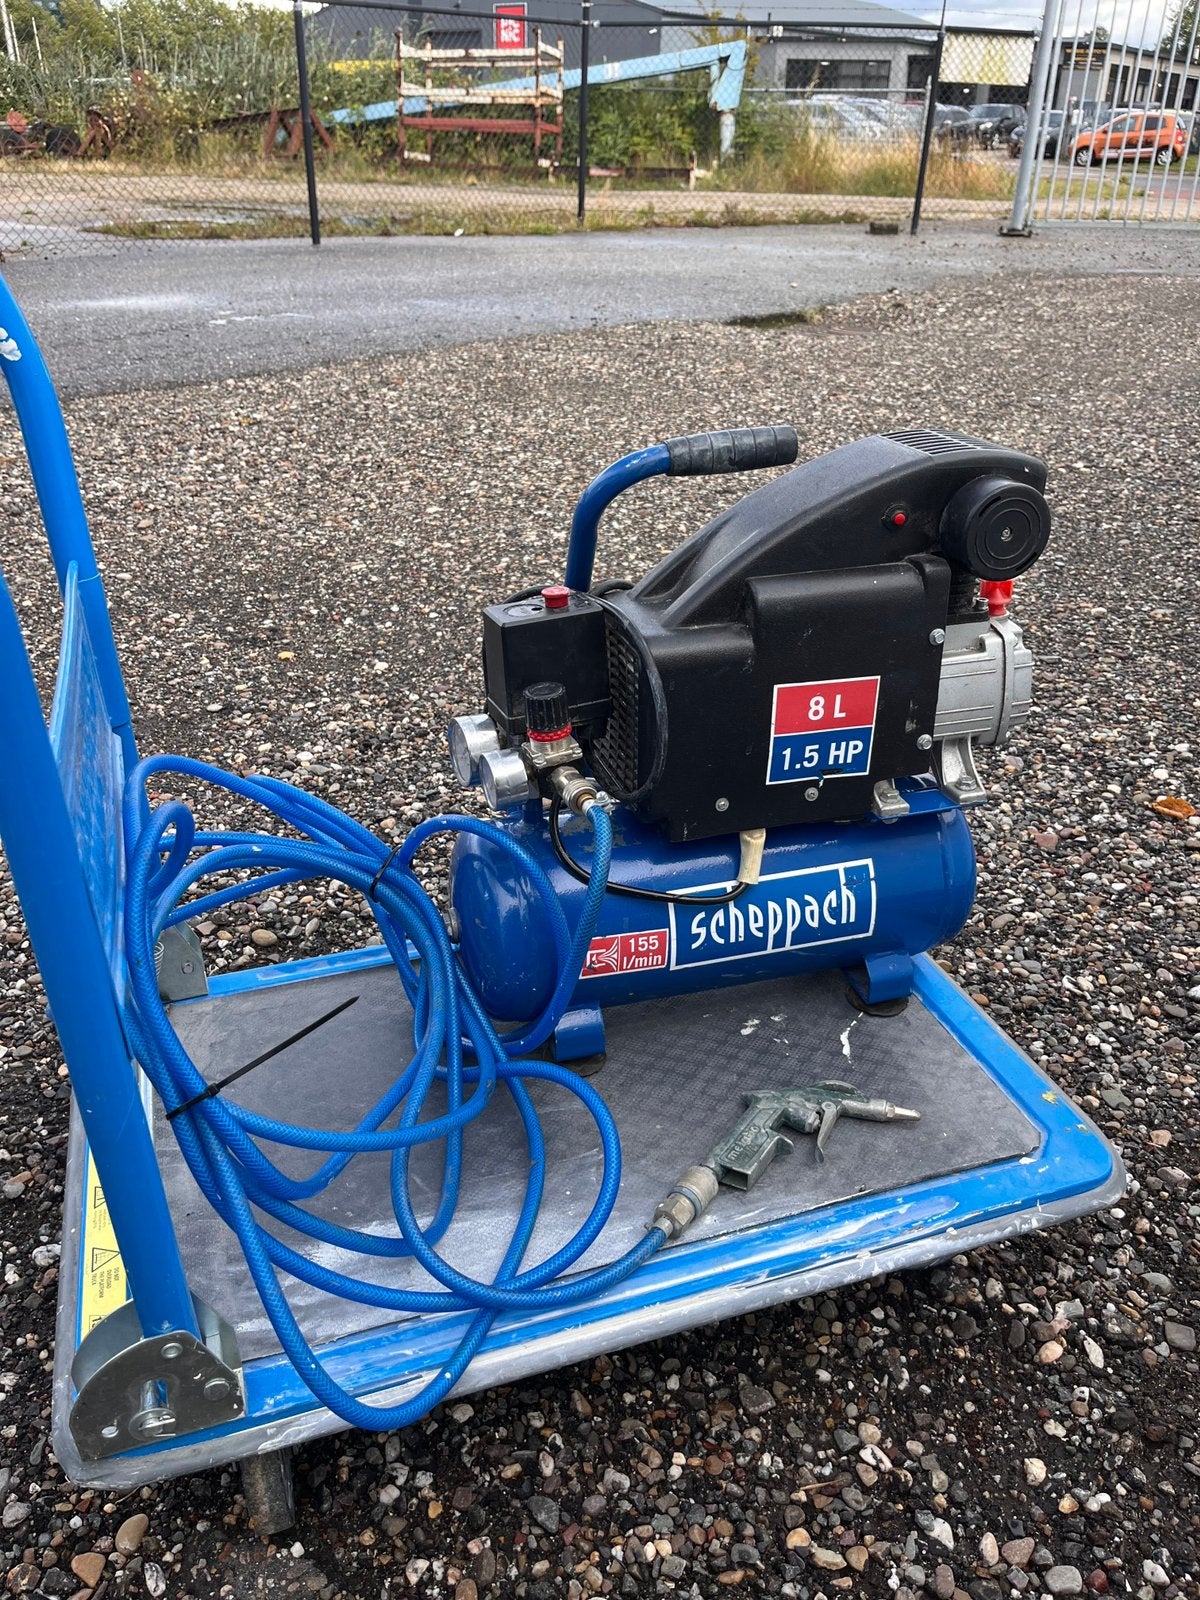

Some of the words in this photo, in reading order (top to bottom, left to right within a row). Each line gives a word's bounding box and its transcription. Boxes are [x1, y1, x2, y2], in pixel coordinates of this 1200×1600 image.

[808, 695, 825, 720] 8
[833, 694, 846, 718] L
[782, 744, 819, 770] 1.5
[828, 740, 864, 765] HP
[690, 872, 856, 951] scheppach
[629, 935, 659, 952] 155
[623, 953, 662, 970] l/min
